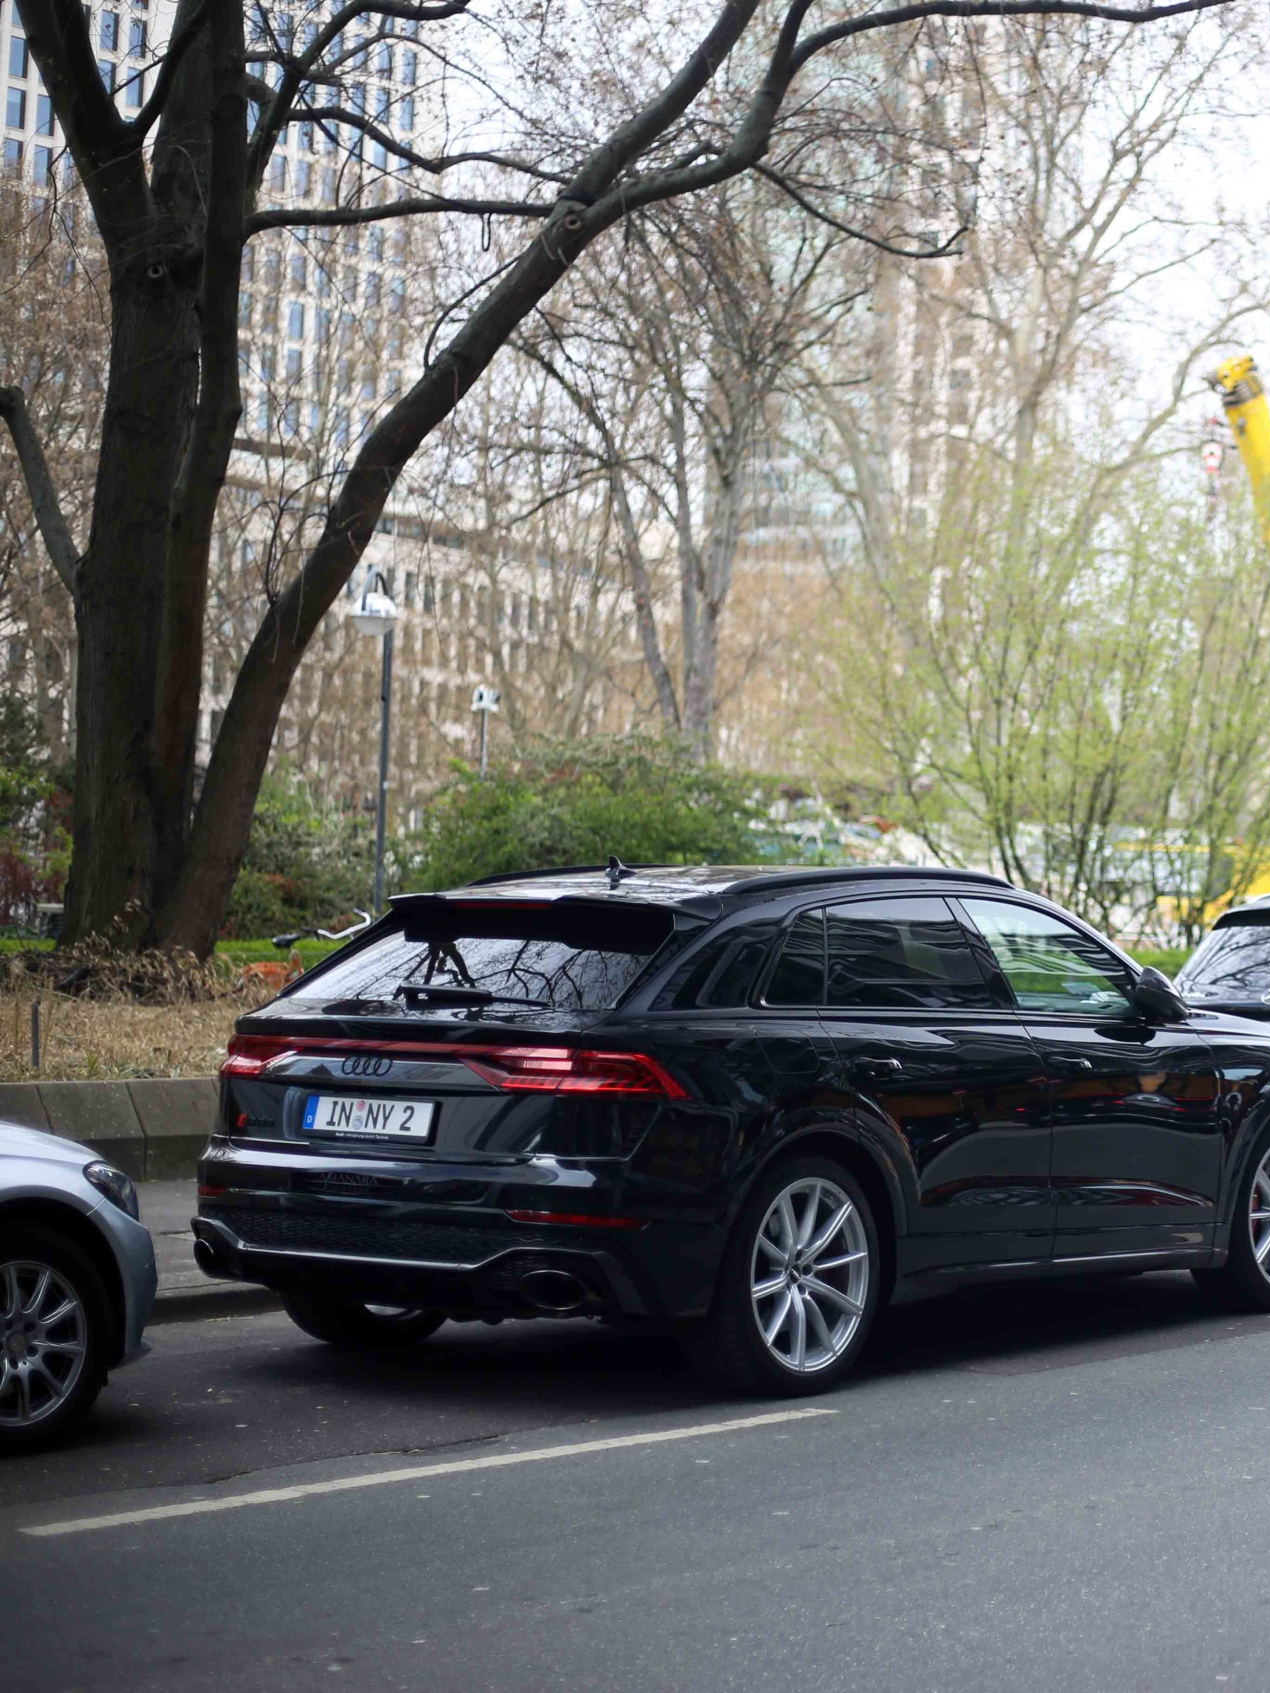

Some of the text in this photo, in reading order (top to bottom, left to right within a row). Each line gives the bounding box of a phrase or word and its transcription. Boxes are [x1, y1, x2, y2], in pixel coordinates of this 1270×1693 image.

[307, 1114, 313, 1123] D
[326, 1101, 415, 1132] IN NY 2
